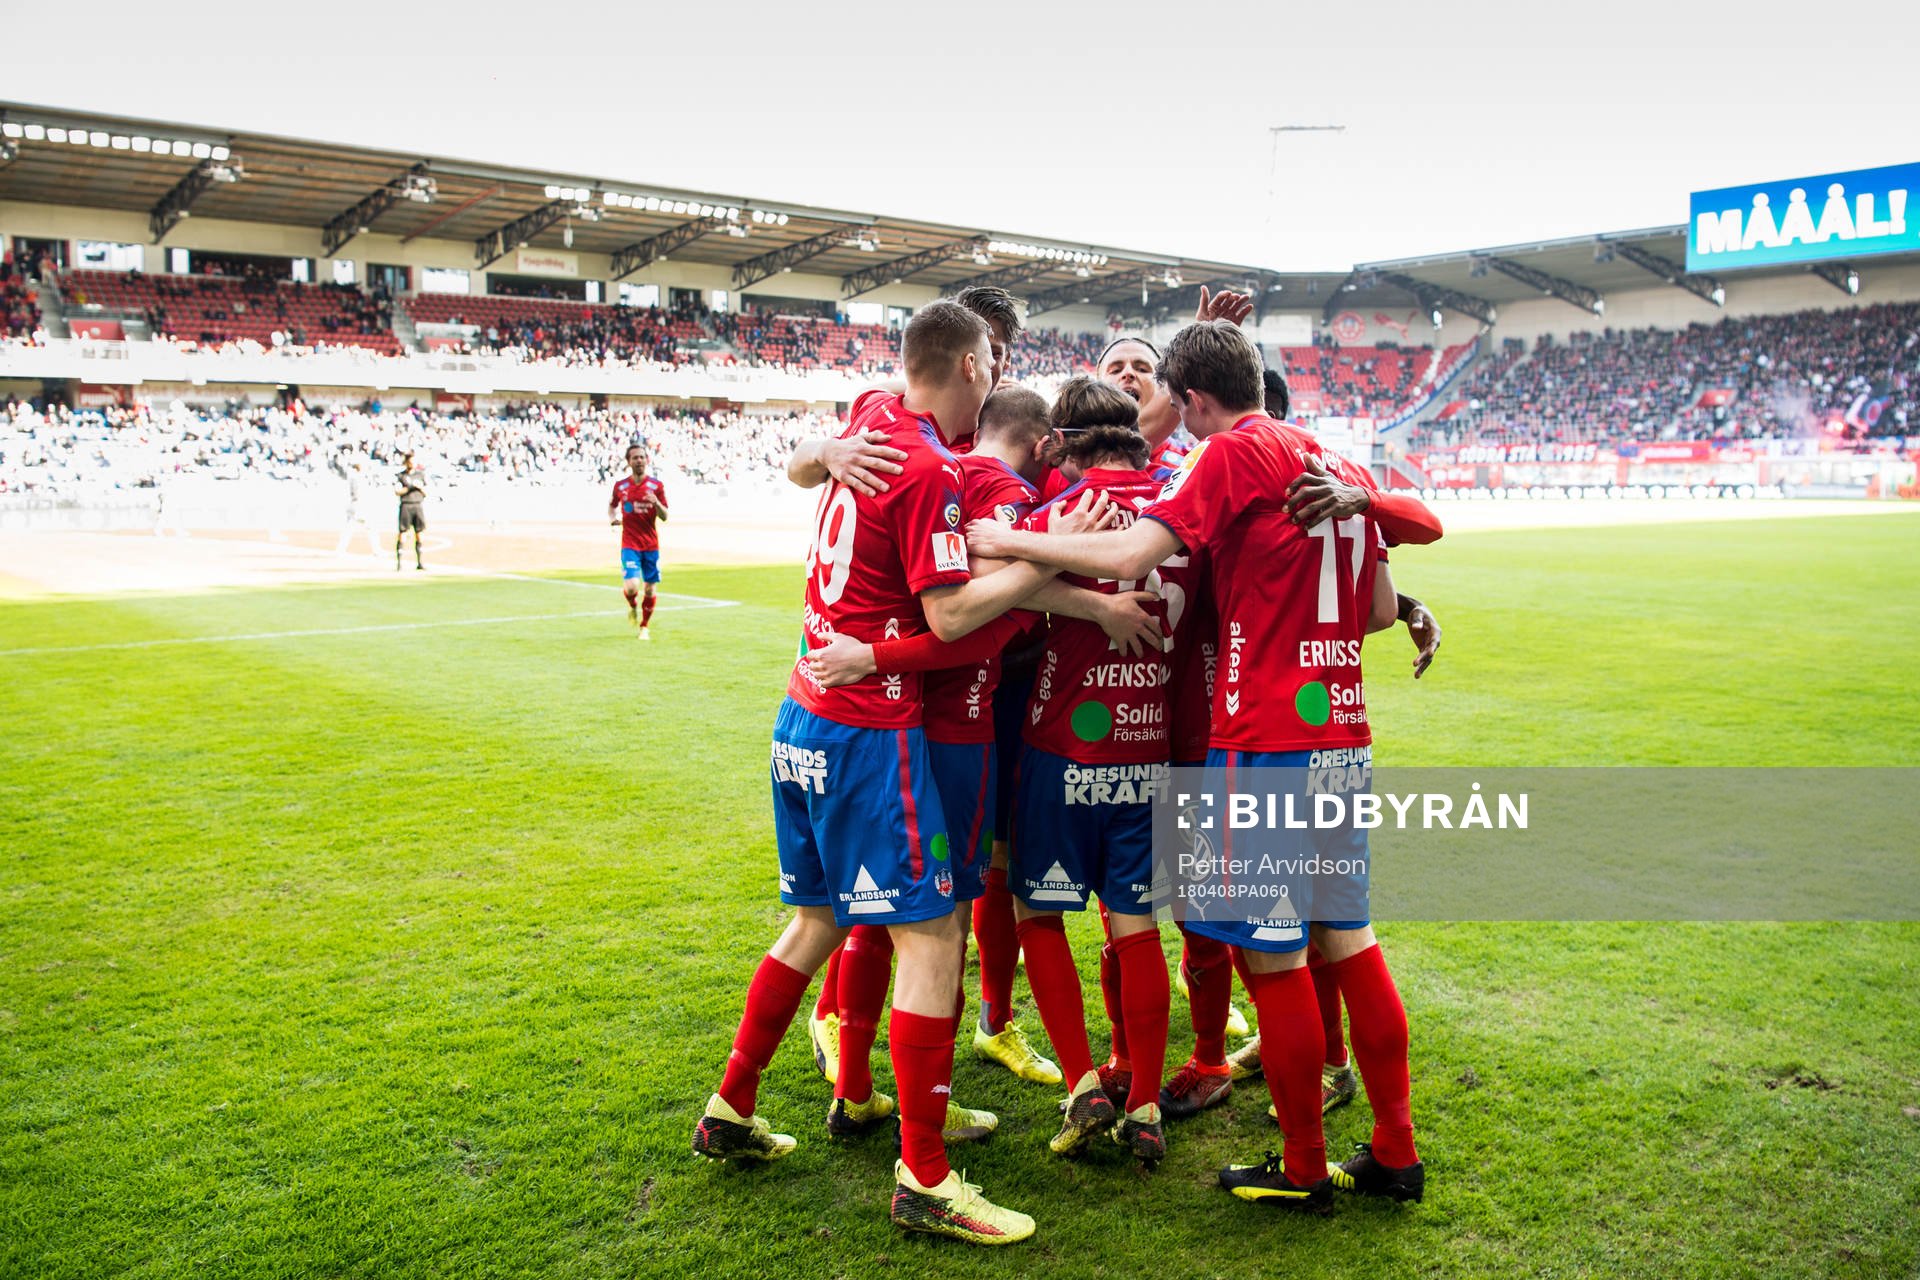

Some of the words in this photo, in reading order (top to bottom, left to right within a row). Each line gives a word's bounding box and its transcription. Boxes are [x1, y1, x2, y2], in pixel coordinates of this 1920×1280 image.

[1697, 183, 1908, 255] MÅÅÅL!
[1227, 622, 1246, 683] akea
[1040, 651, 1057, 700] akea
[966, 669, 987, 718] akea
[1116, 703, 1163, 724] Solid
[1064, 762, 1171, 784] ÖRESUNDS
[1065, 779, 1171, 806] KRAFT
[839, 888, 900, 902] ERLANDSSON
[1025, 879, 1085, 891] ERLANDSSO
